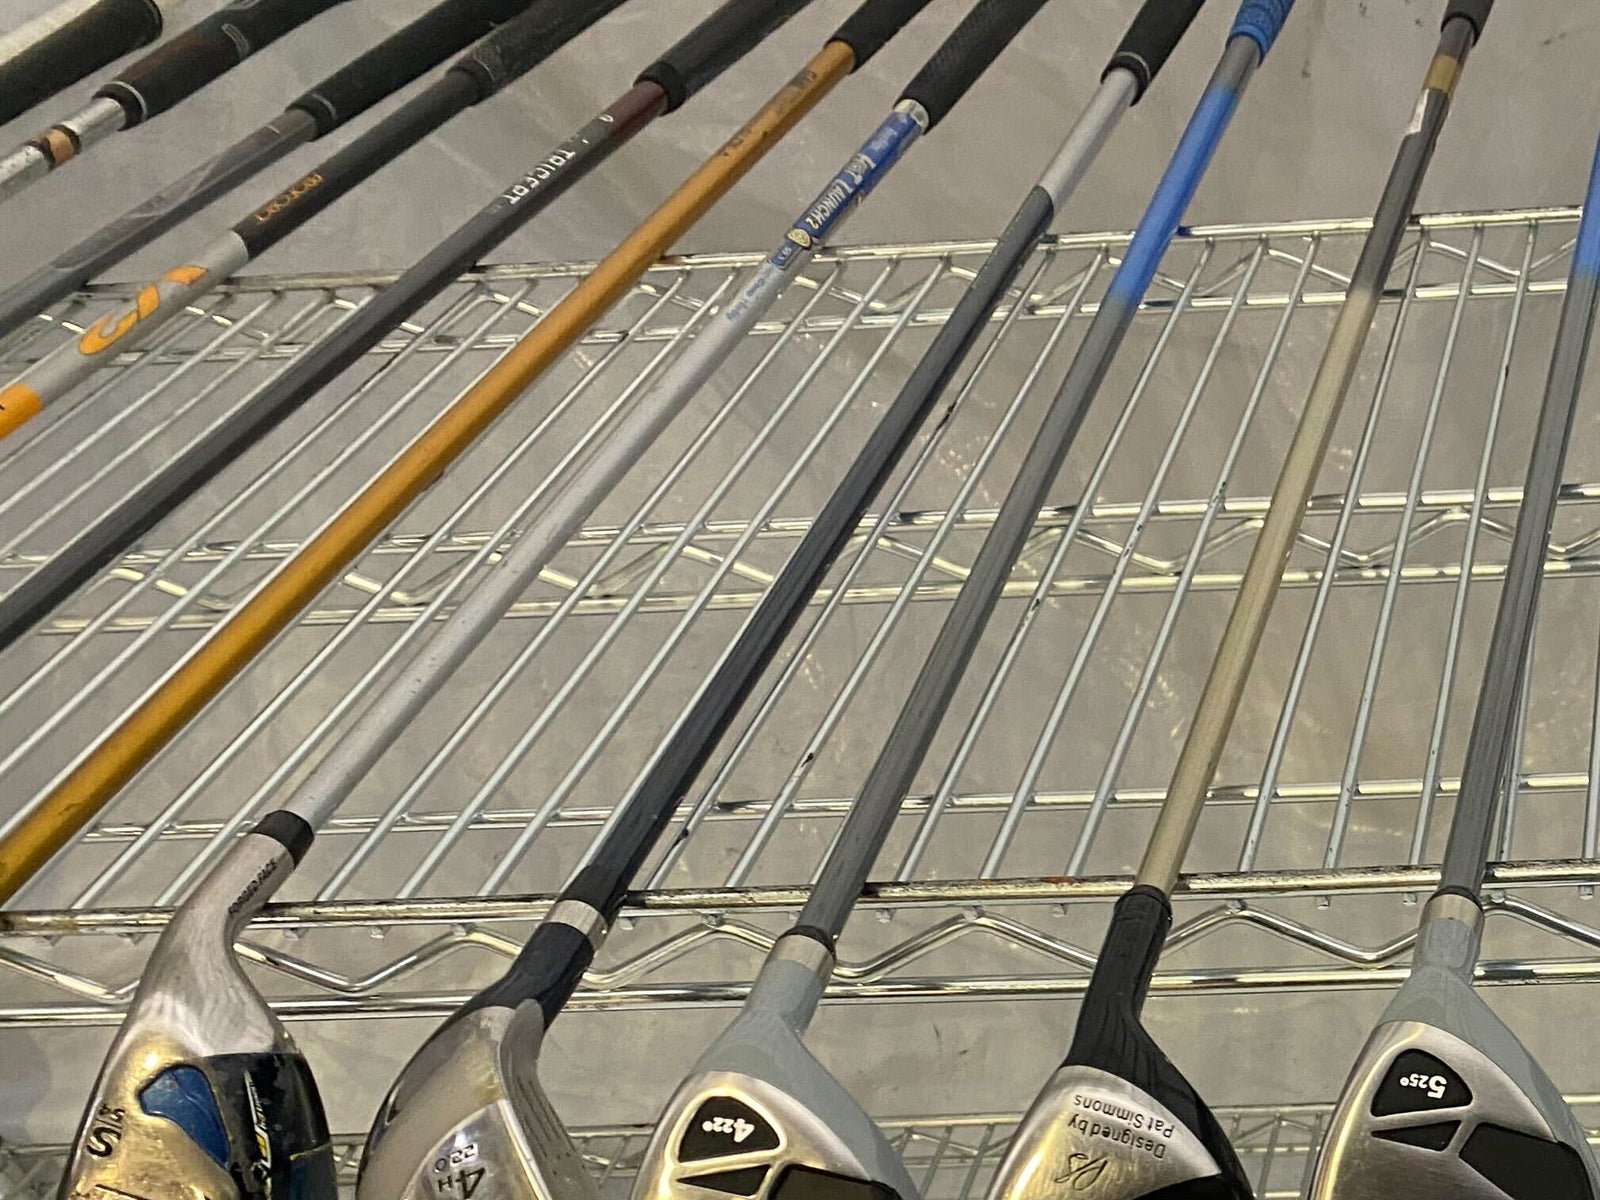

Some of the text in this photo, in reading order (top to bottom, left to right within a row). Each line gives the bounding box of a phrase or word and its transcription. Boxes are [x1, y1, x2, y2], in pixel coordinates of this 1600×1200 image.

[1067, 1113, 1167, 1159] Designed by
[1074, 1094, 1176, 1139] Pat Simmons
[86, 1126, 122, 1158] S
